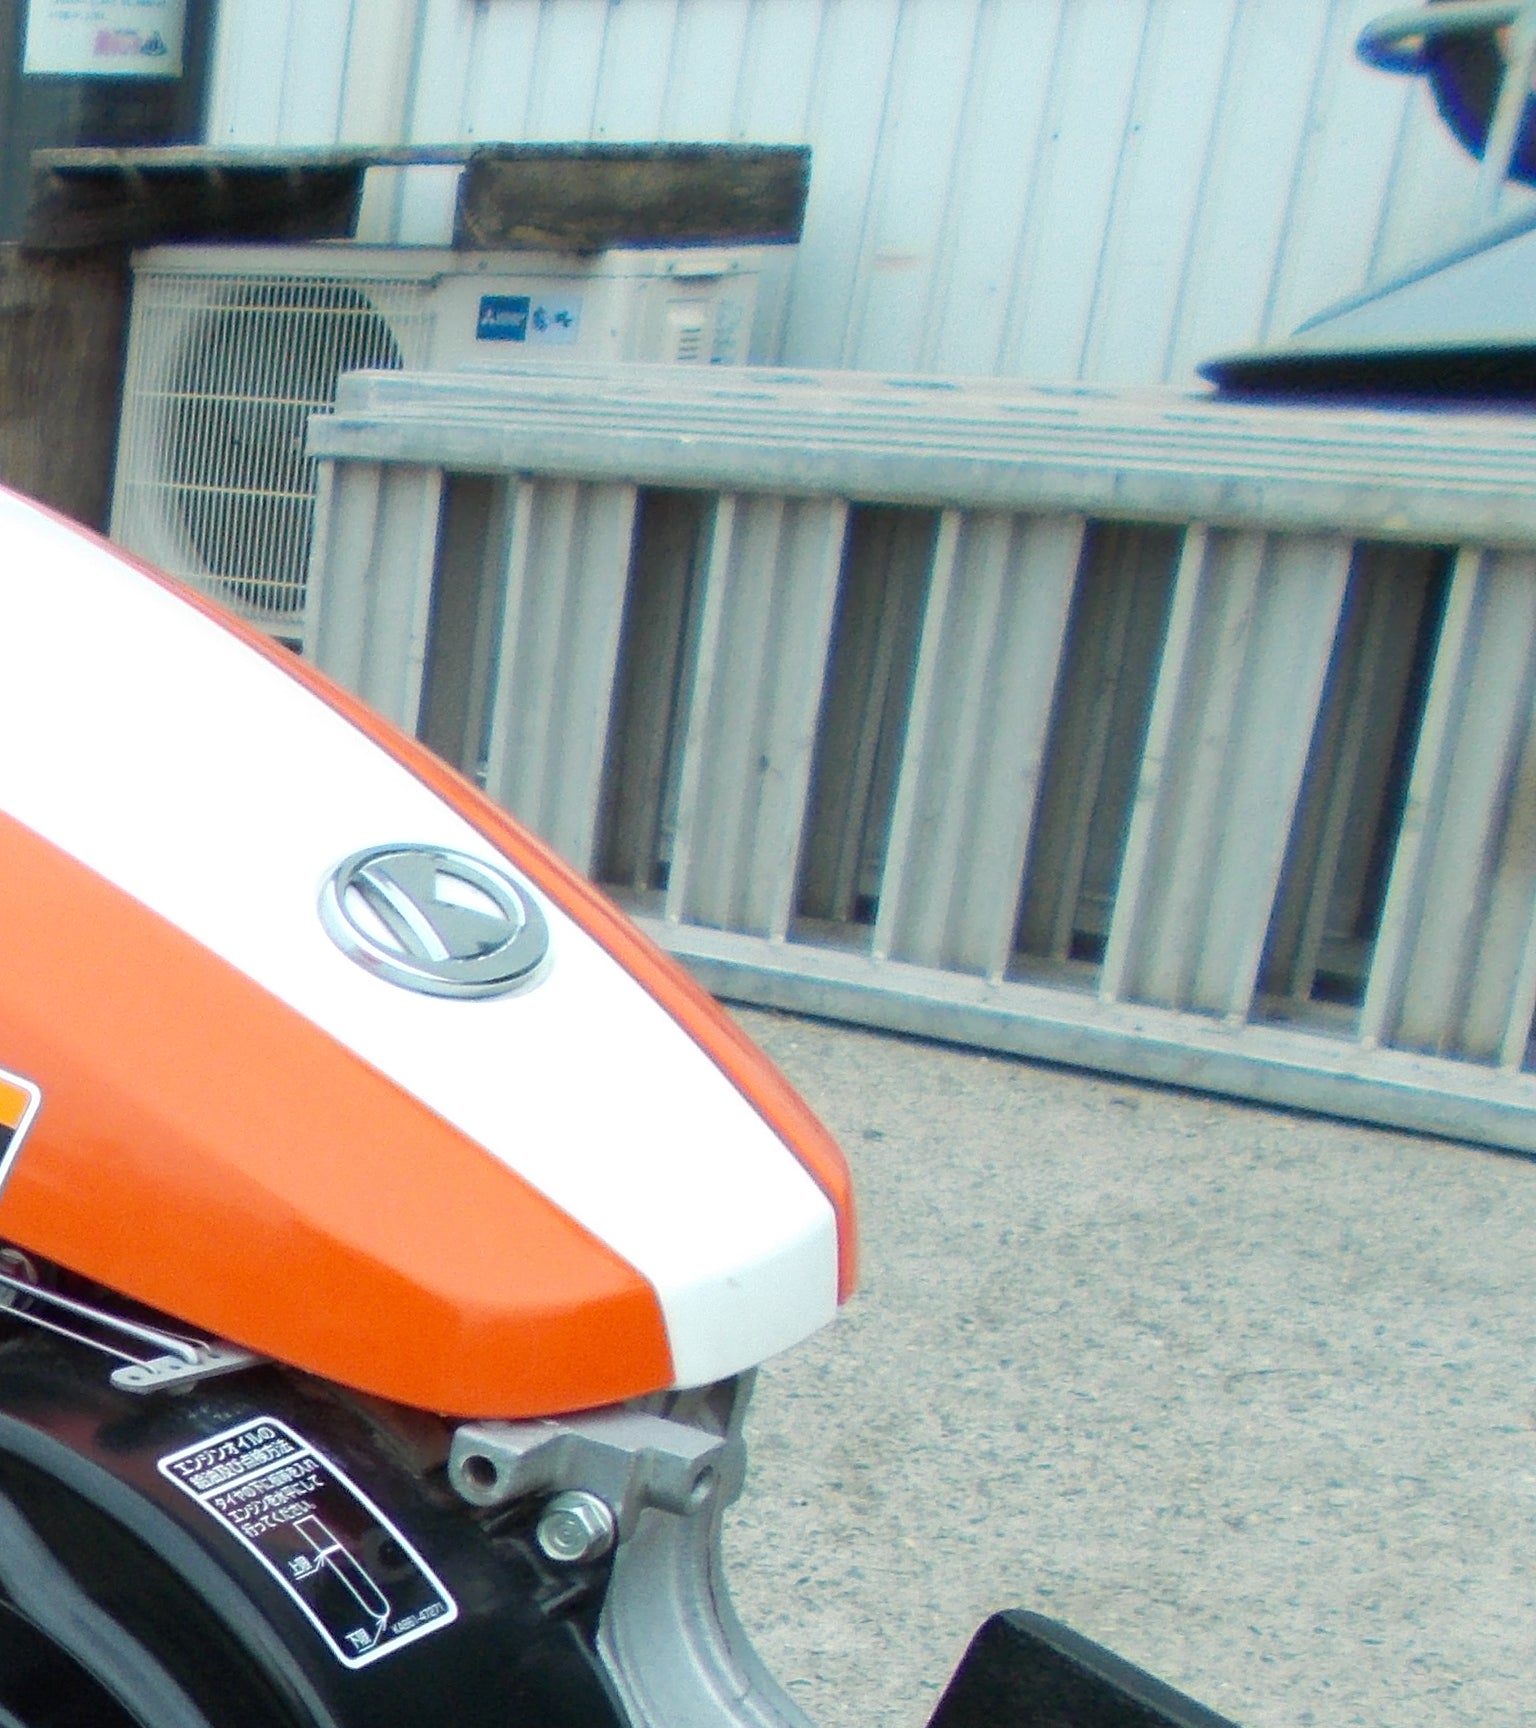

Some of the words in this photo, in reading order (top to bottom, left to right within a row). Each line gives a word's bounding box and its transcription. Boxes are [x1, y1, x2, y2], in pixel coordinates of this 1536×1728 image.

[173, 1426, 276, 1477] エンジンオイルの
